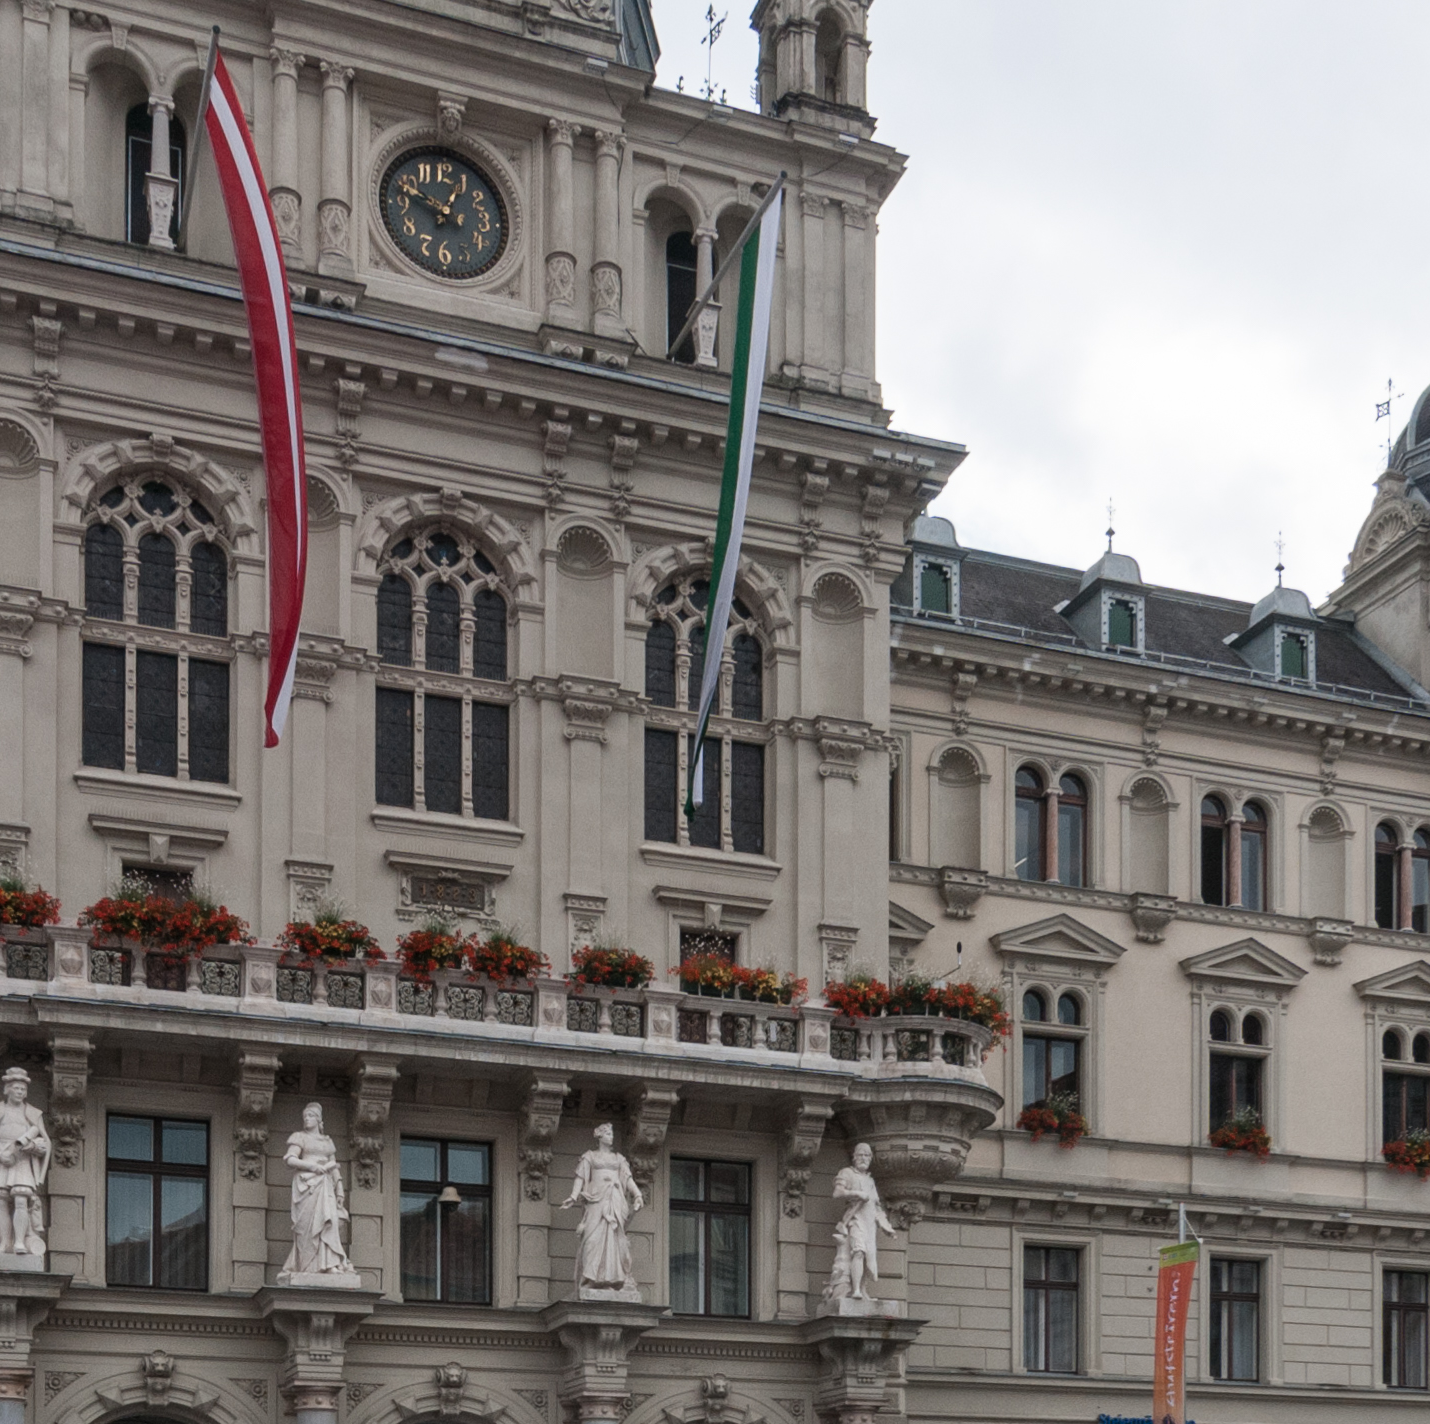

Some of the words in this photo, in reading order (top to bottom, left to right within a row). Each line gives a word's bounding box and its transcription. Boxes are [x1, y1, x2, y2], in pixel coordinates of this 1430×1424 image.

[418, 163, 431, 184] 11
[436, 163, 453, 185] 12
[397, 194, 410, 215] 9
[472, 190, 485, 211] 2
[403, 216, 416, 236] 8
[478, 211, 491, 233] 3
[419, 234, 433, 257] 7
[472, 231, 490, 252] 4
[438, 240, 452, 265] 6
[458, 243, 471, 263] 5
